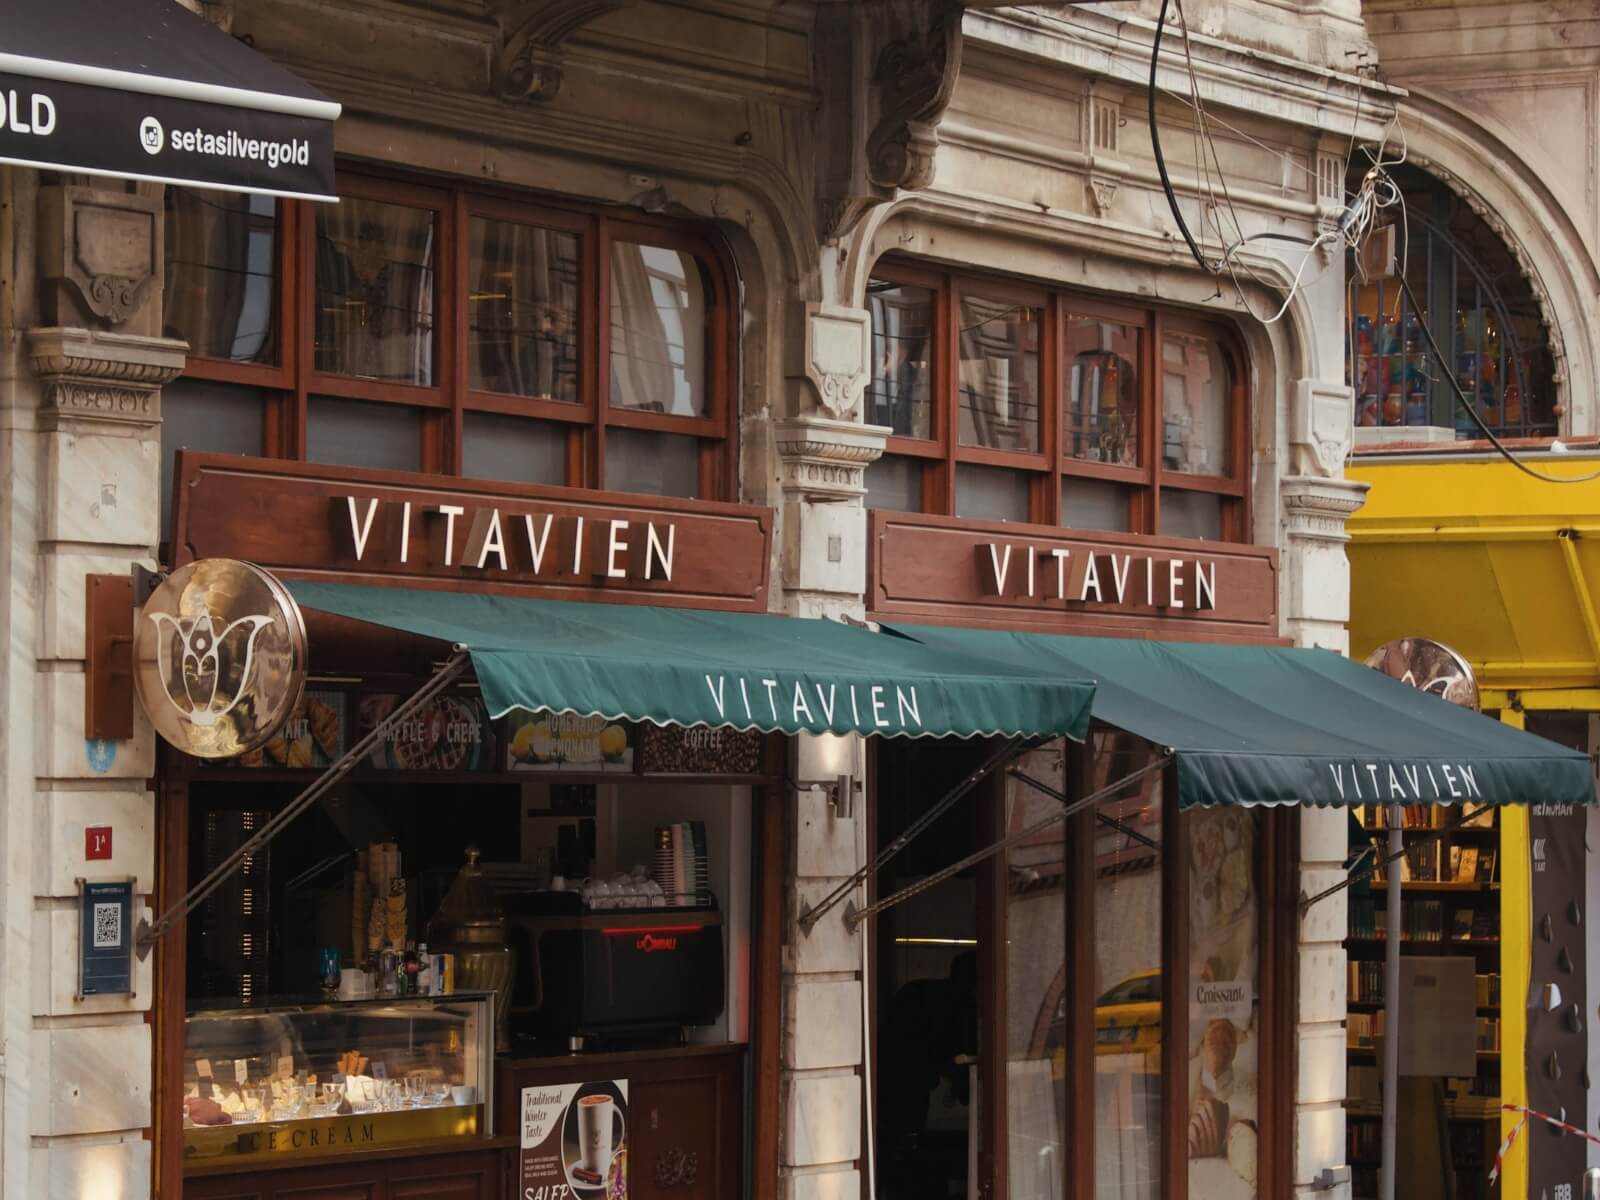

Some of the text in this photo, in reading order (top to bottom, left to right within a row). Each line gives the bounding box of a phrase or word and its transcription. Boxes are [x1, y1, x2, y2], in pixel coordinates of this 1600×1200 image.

[170, 128, 309, 168] setasilvergold
[347, 495, 675, 582] VITAVIEN
[989, 543, 1216, 611] VITAVIEN
[705, 674, 922, 727] VITAVIEN
[684, 728, 722, 748] COFFEE
[1328, 763, 1481, 799] VITAVIEN
[526, 1090, 562, 1107] Traditional
[291, 1124, 374, 1148] CREAM
[525, 1124, 543, 1139] Taste
